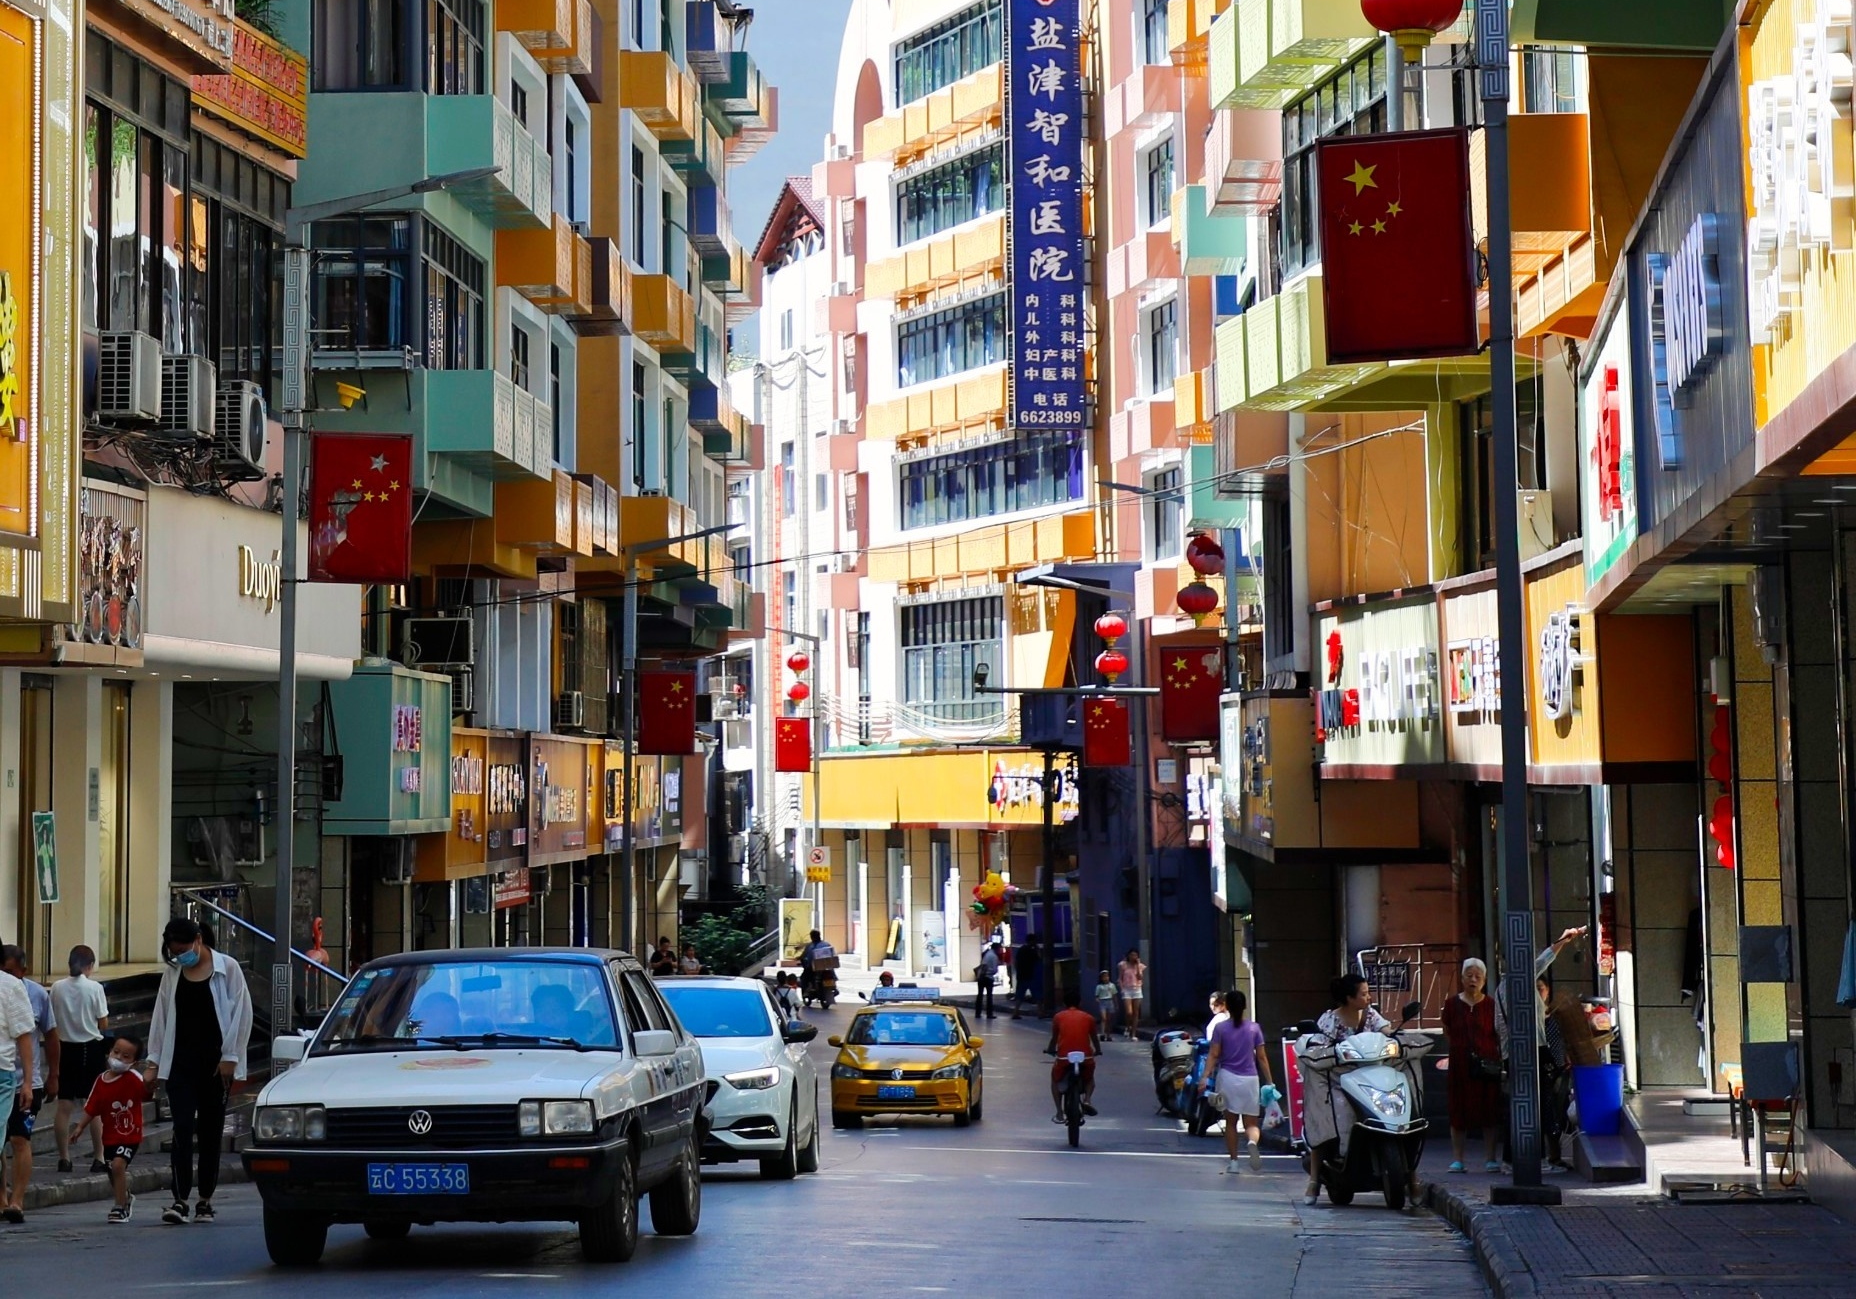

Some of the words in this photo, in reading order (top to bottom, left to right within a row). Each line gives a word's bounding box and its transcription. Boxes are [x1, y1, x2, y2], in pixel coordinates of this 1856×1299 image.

[1025, 17, 1074, 282] 盐津智和医院
[1025, 294, 1076, 308] 内科
[1025, 312, 1076, 326] 儿科
[1025, 330, 1076, 345] 外科
[1025, 348, 1077, 363] 妇产科
[1024, 367, 1077, 381] 中医科
[1033, 393, 1068, 406] 电话
[1020, 410, 1081, 424] 6623899
